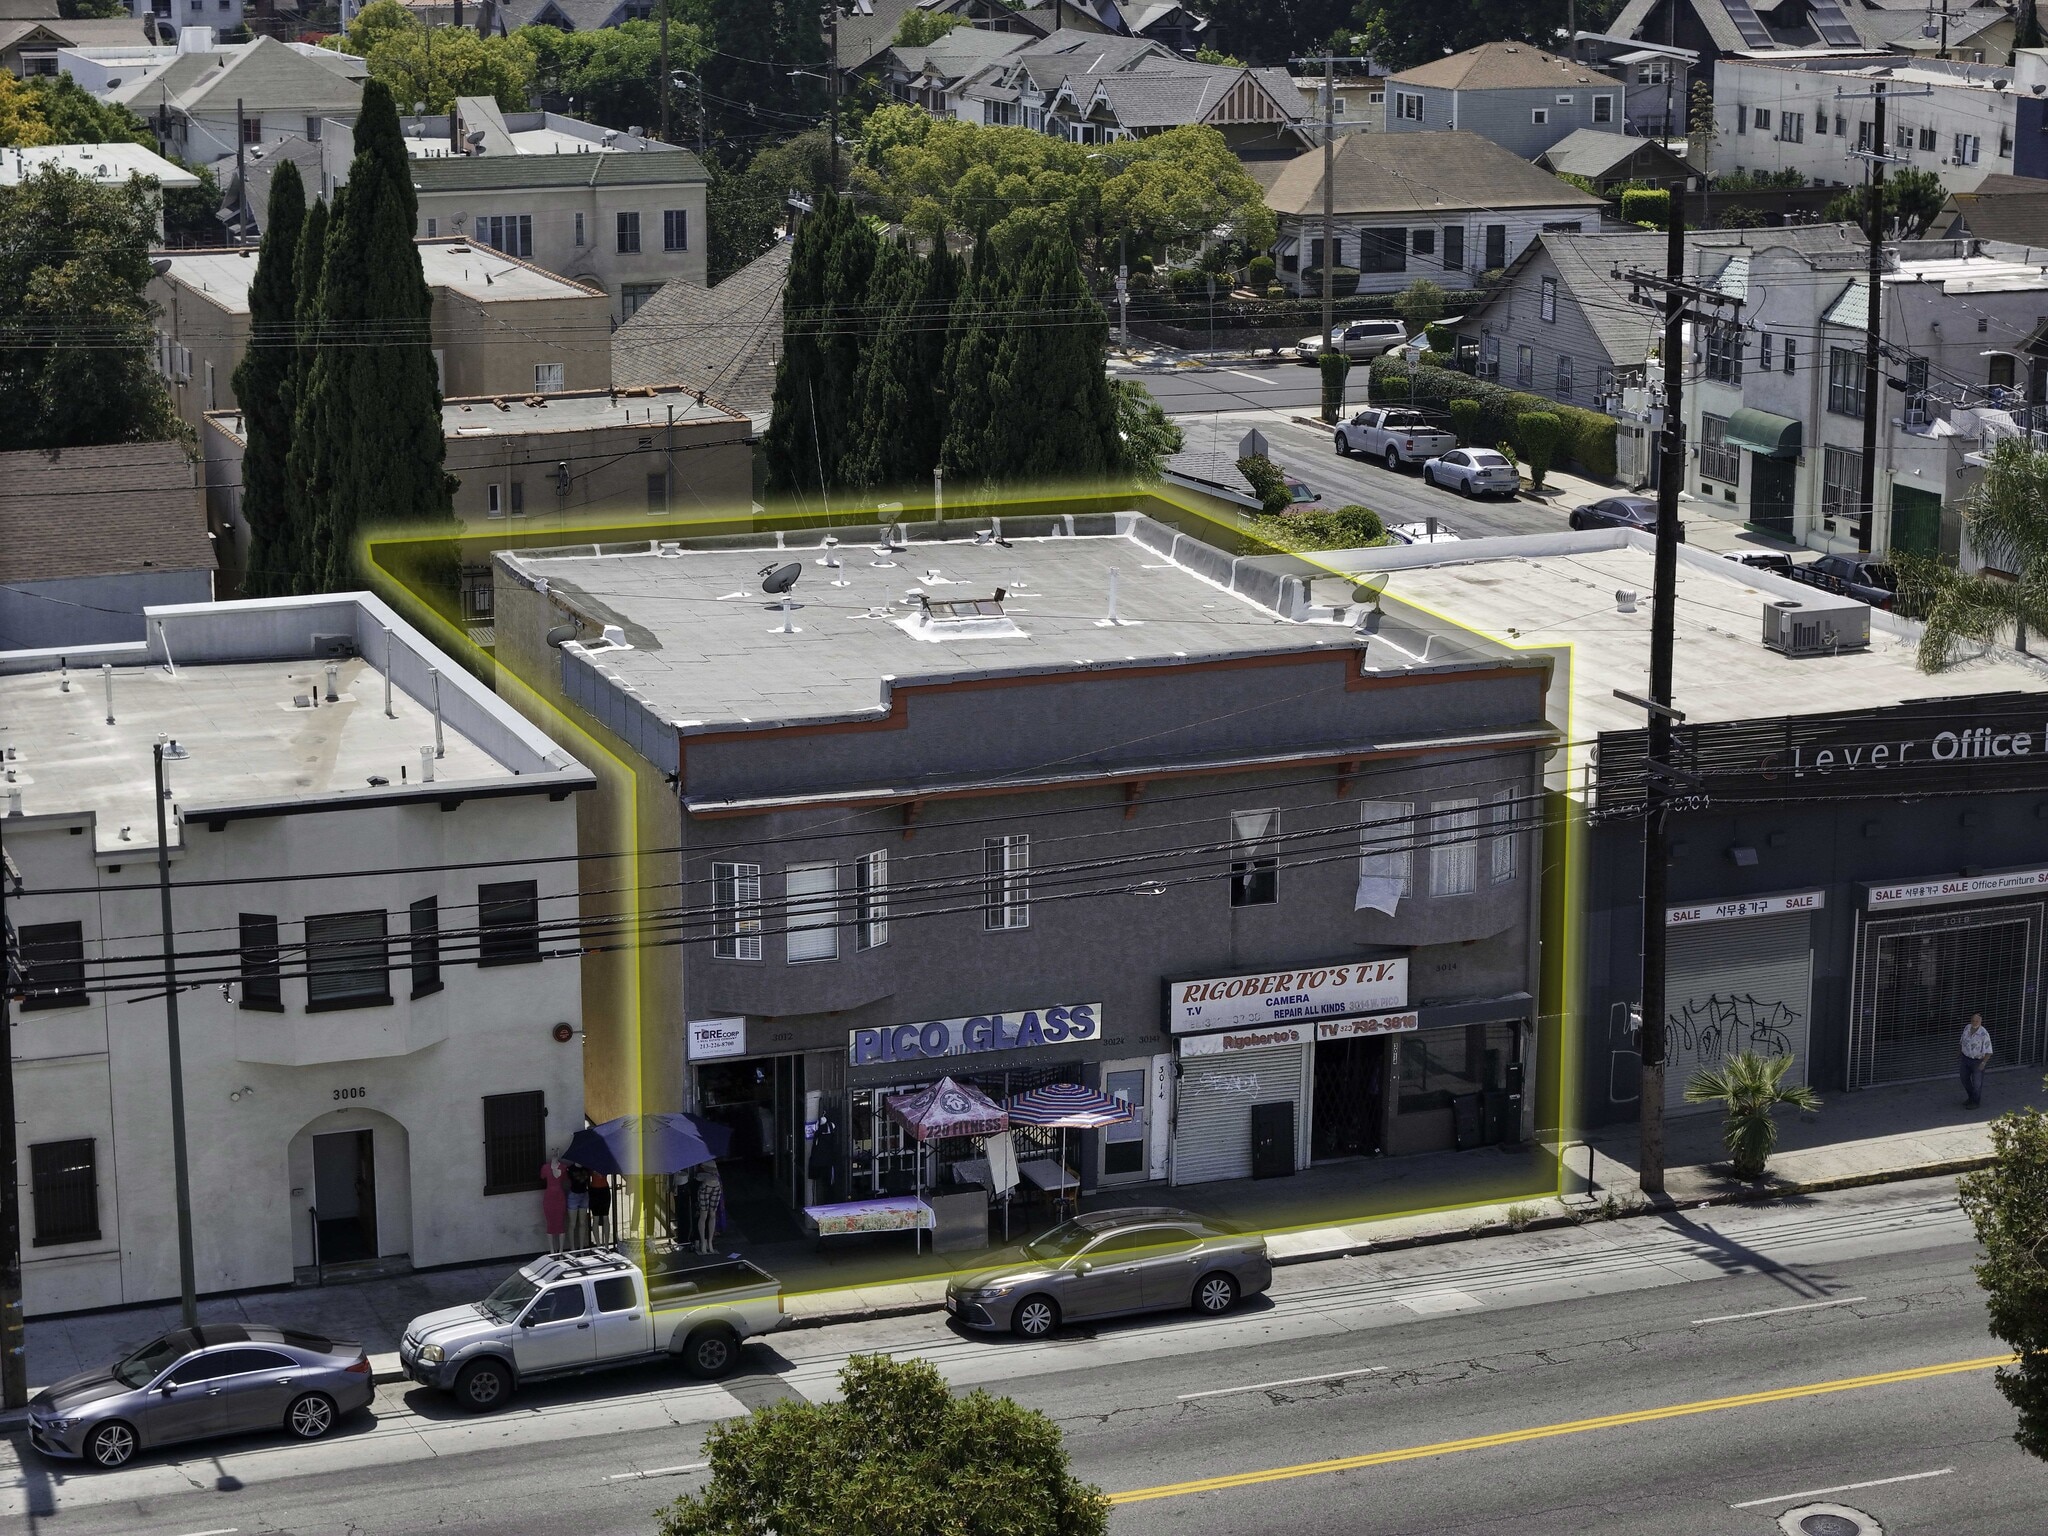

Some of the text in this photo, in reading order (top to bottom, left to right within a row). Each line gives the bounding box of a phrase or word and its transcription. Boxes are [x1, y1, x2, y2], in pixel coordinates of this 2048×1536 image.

[1931, 727, 2032, 760] Office
[1875, 889, 1902, 901] SALE
[1905, 885, 1939, 898] 사무용가구
[1942, 882, 1969, 894] SALE
[1972, 879, 1997, 891] Office
[1998, 874, 2035, 888] Furniture
[1673, 896, 1813, 922] SALE 사무용가구 SALE
[1182, 962, 1396, 1004] RIGOBERTO'S T.V.
[1265, 994, 1310, 1007] CAMERA
[1273, 1007, 1304, 1019] REPAIR
[1304, 1005, 1320, 1017] ALL
[1321, 1002, 1346, 1014] KINDS
[772, 1031, 794, 1041] 3012
[854, 1004, 1096, 1065] PICO GLASS
[1223, 1028, 1300, 1050] Rigoberto's
[1319, 1023, 1339, 1037] TV
[333, 1086, 366, 1101] 3006
[951, 1117, 1001, 1136] FITNESS
